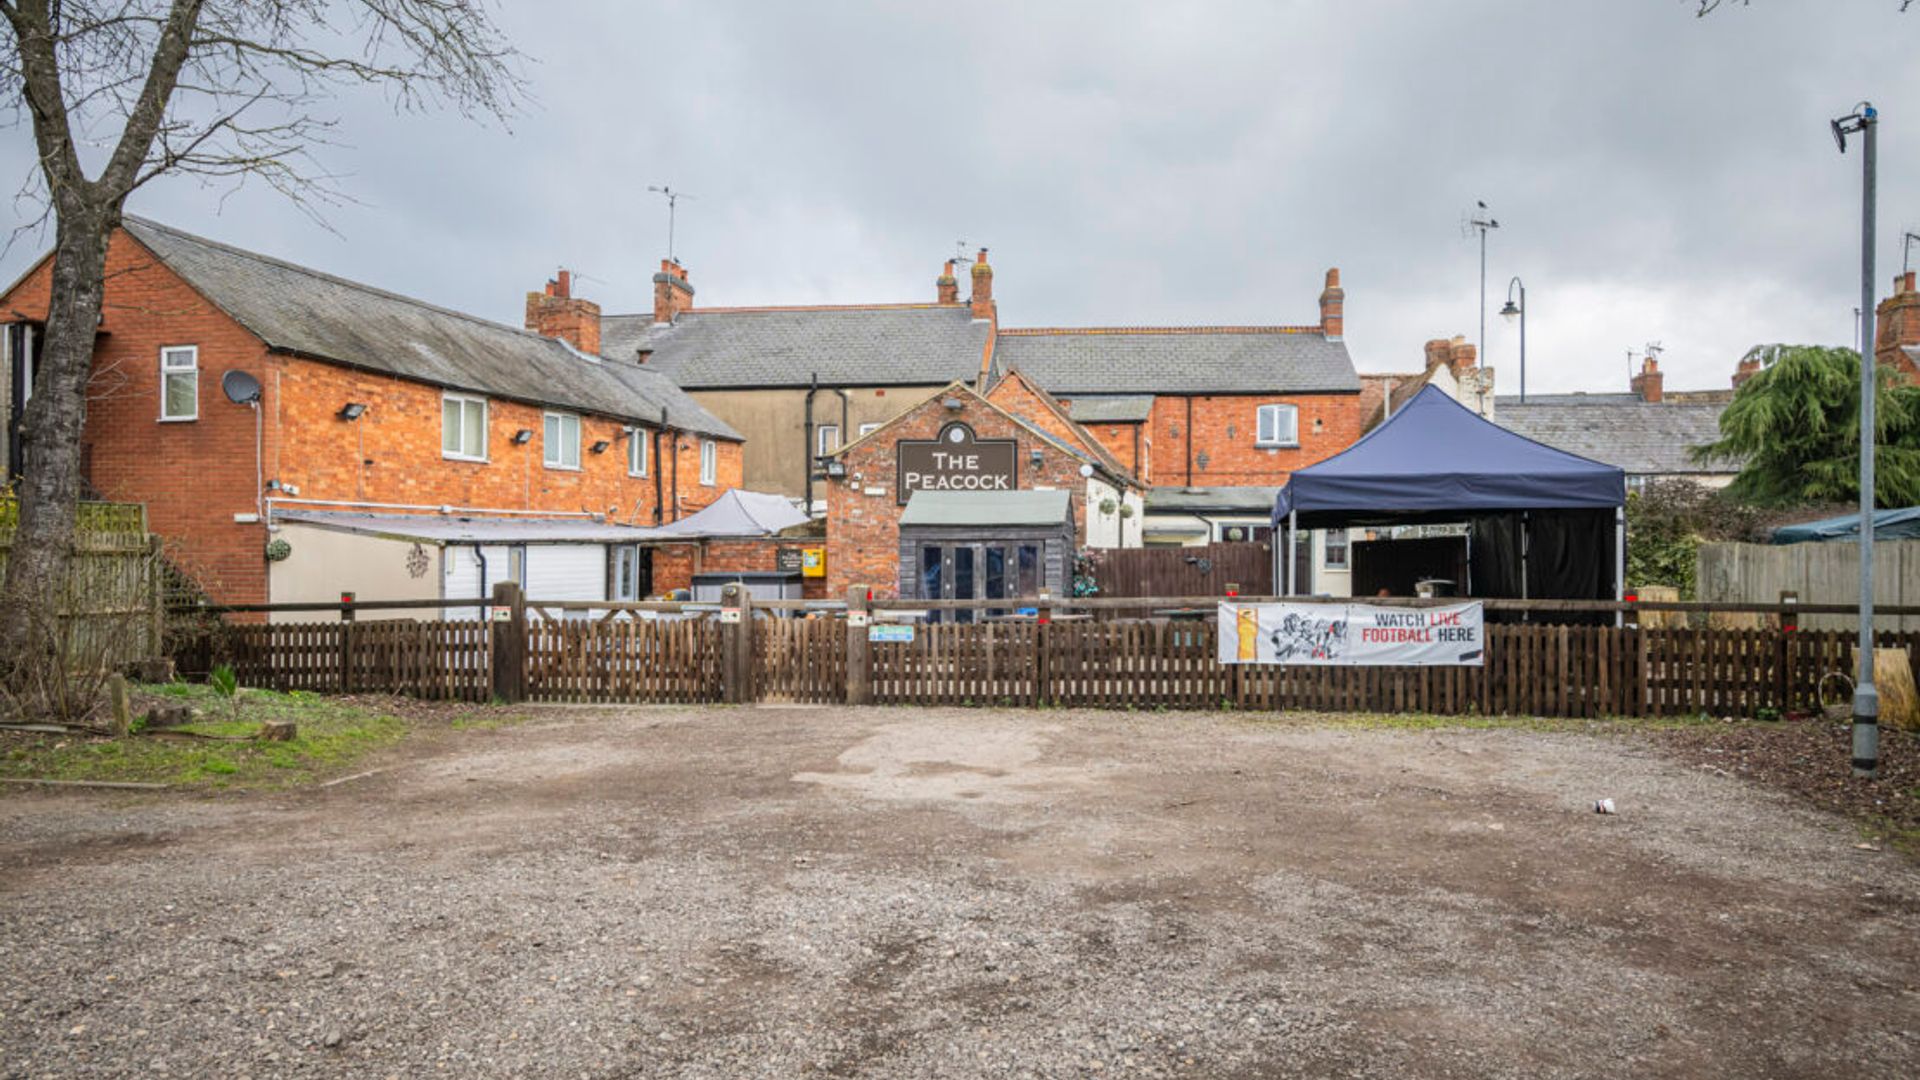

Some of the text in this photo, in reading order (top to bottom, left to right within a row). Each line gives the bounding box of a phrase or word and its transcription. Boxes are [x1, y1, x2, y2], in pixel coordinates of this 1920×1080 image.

[932, 452, 979, 469] THE
[905, 472, 1009, 489] PEACOCK
[1375, 611, 1461, 627] WATCH LIVE
[1362, 628, 1475, 643] FOOTBALL HERE
